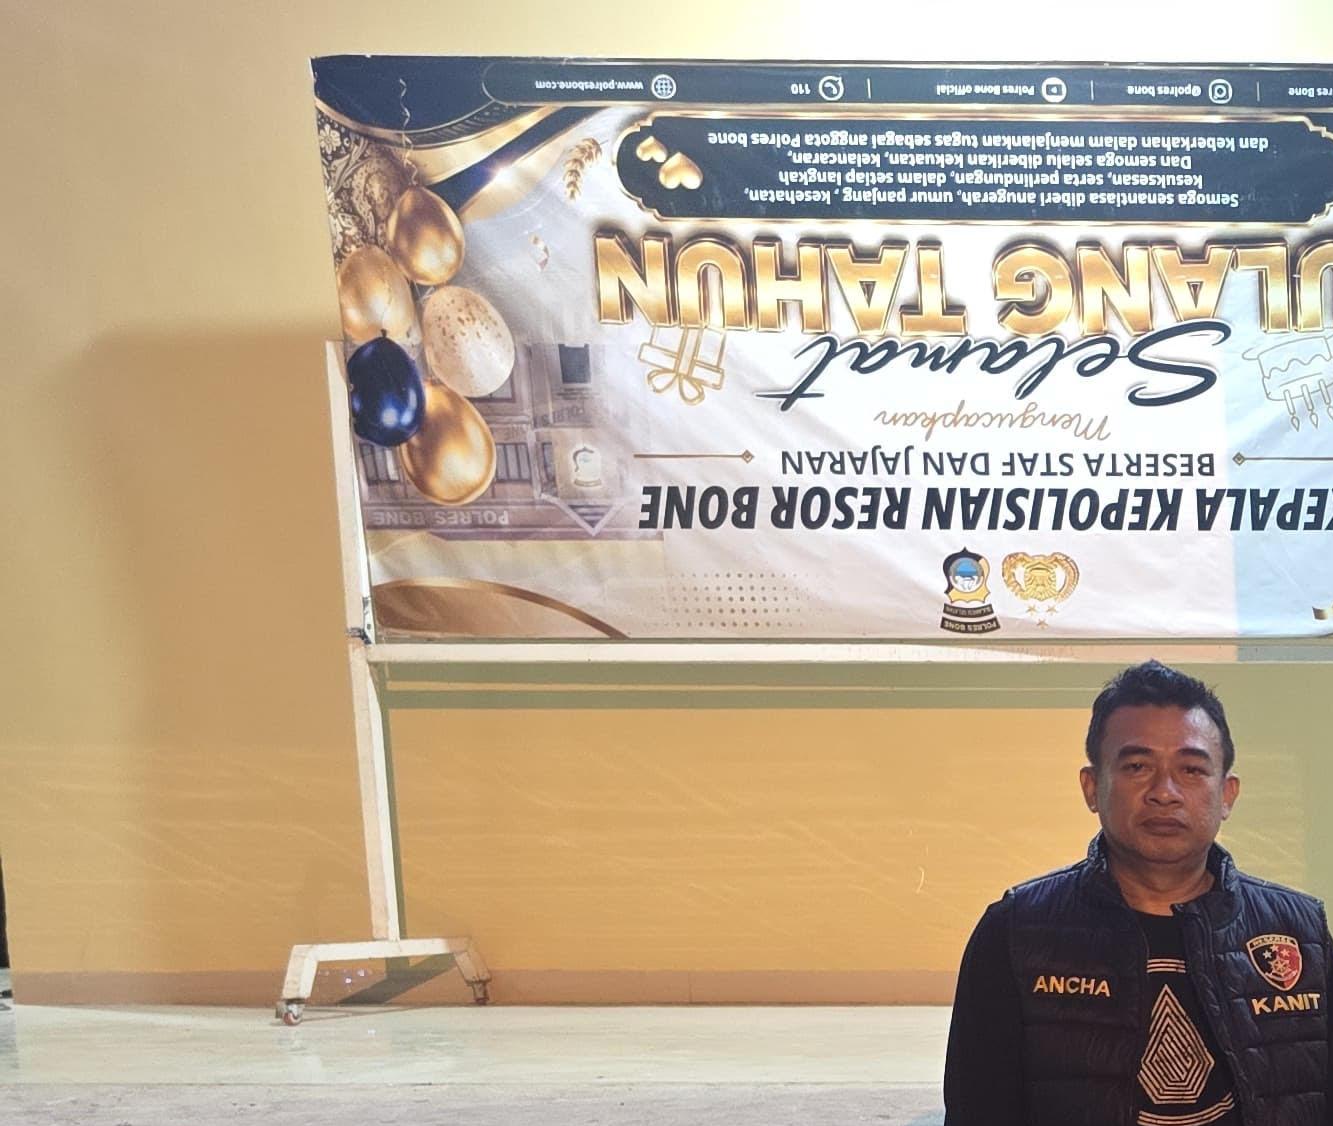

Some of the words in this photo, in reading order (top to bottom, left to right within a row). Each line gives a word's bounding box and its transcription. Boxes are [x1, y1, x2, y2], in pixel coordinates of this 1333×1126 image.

[535, 79, 644, 92] www.polresbone.com
[790, 83, 811, 95] 110
[936, 84, 973, 95] official
[974, 84, 1000, 95] Bone
[1002, 84, 1035, 95] Polres
[1127, 85, 1155, 96] bone
[1157, 83, 1202, 97] @polres
[1288, 87, 1315, 98] Bone
[707, 131, 748, 146] bone
[751, 133, 800, 147] Polres
[804, 130, 867, 146] anggota
[872, 131, 931, 148] sebagai
[935, 131, 978, 146] tugas
[982, 131, 1084, 149] menjalankan
[1089, 136, 1137, 150] dalam
[1142, 136, 1235, 152] keberkahan
[1239, 137, 1269, 151] dan
[787, 151, 880, 167] kelancaran,
[884, 151, 963, 168] kekuatan,
[968, 153, 1042, 168] diberikan
[1047, 154, 1092, 168] selalu
[1096, 151, 1157, 166] semoga
[1160, 155, 1192, 169] Dan
[778, 168, 842, 185] langkah
[845, 168, 894, 185] setiap
[897, 172, 946, 186] dalam
[950, 170, 1059, 187] perlindungan,
[1064, 173, 1104, 186] serta
[1107, 172, 1203, 189] kesuksesan,
[744, 187, 831, 204] kesehatan,
[910, 190, 953, 202] umur
[956, 189, 1036, 206] anugerah,
[1040, 192, 1085, 206] diberi
[1090, 192, 1174, 207] senantiasa
[1178, 190, 1239, 207] Semoga
[592, 230, 968, 338] TAHUN
[755, 320, 1231, 412] Selamat
[873, 399, 1111, 442] Mengucapkan
[781, 445, 914, 476] JAJARAN
[922, 451, 990, 476] DAN
[1001, 452, 1074, 477] STAF
[1084, 452, 1215, 477] BESERTA
[638, 485, 760, 530] BONE
[770, 486, 912, 530] RESOR
[921, 487, 1183, 532] KEPOLISIAN
[372, 511, 420, 525] BONE
[434, 509, 509, 526] POLRES
[1033, 976, 1111, 997] ANCHA
[1251, 993, 1321, 1015] KANIT
